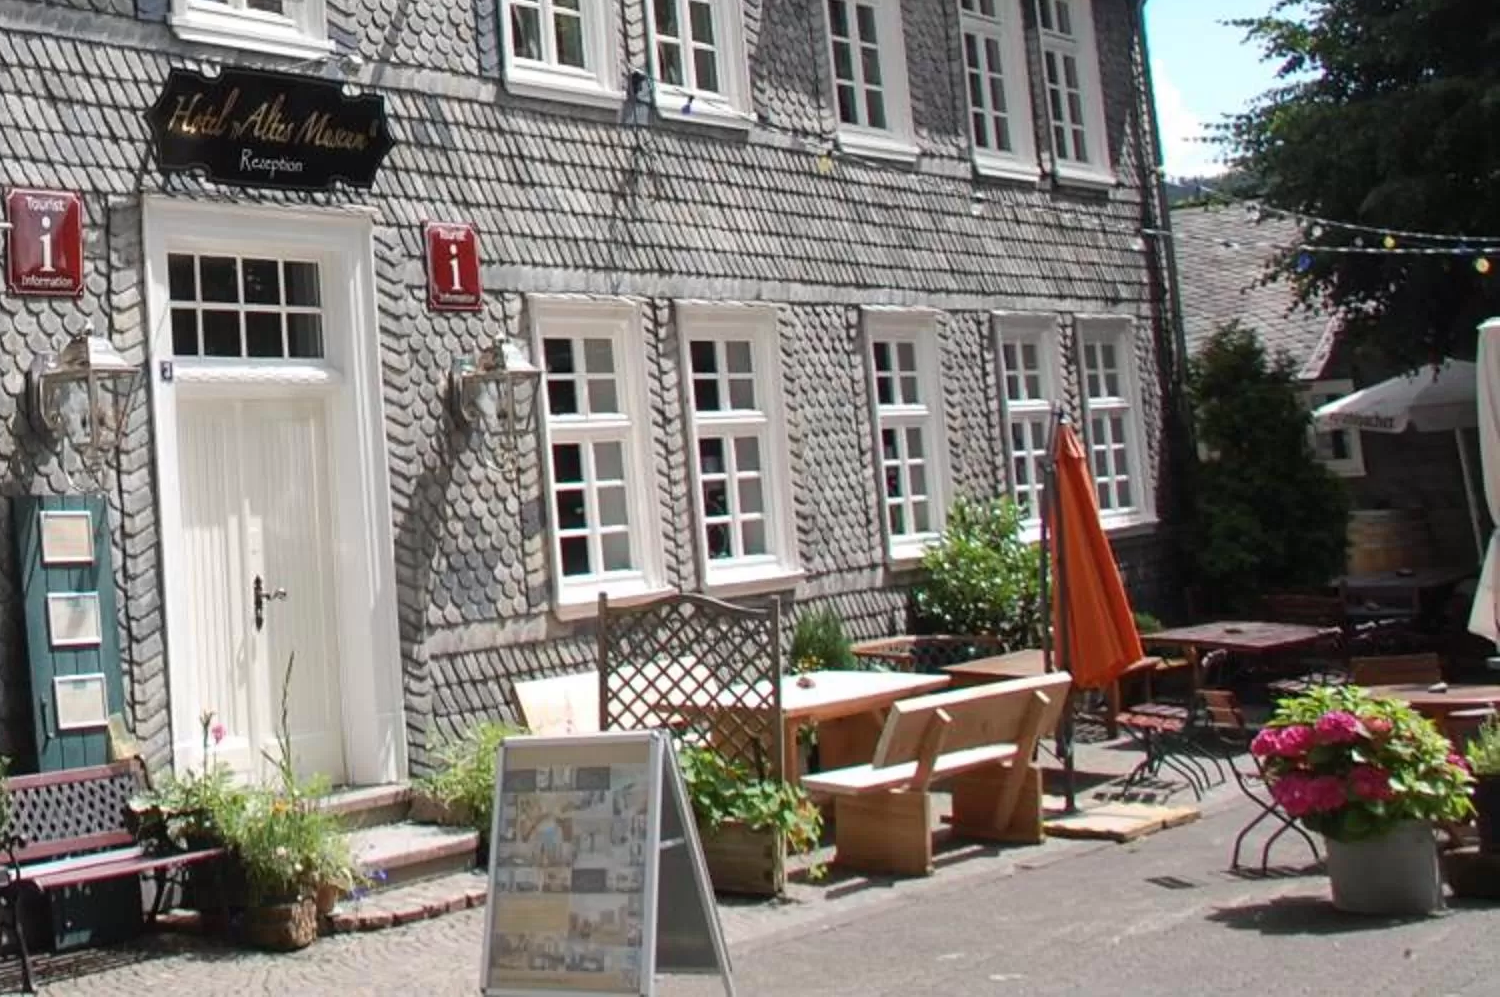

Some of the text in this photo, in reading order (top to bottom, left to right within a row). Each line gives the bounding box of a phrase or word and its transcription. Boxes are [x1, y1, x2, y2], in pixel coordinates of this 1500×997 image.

[168, 87, 239, 135] Hotel
[25, 196, 66, 211] Tourist
[21, 275, 74, 286] Information
